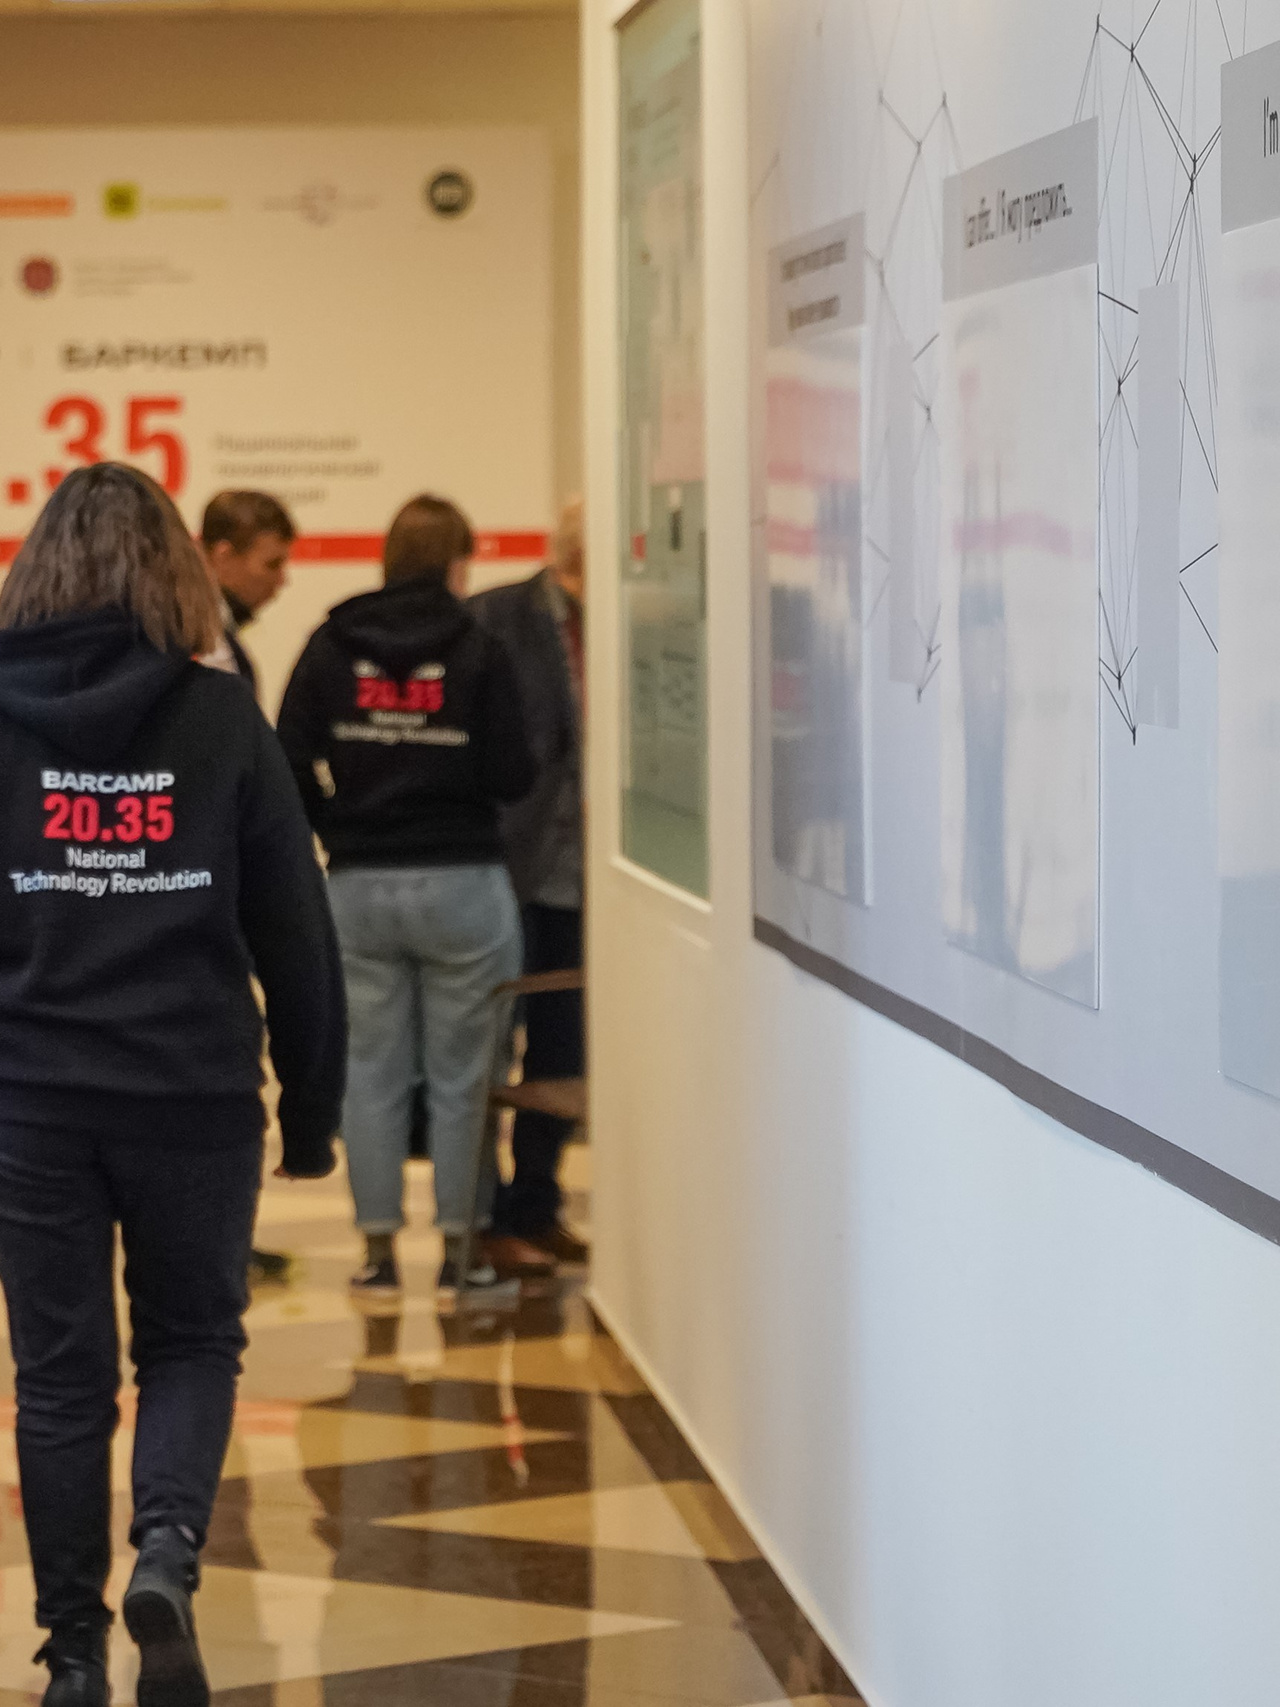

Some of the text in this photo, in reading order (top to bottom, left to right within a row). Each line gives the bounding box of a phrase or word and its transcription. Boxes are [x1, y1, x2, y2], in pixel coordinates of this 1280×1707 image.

[60, 338, 268, 371] БАРКЕМП
[41, 769, 175, 794] BARCAMP
[43, 793, 175, 843] 20.35
[65, 846, 147, 870] National
[8, 869, 213, 898] Technology Revolution
